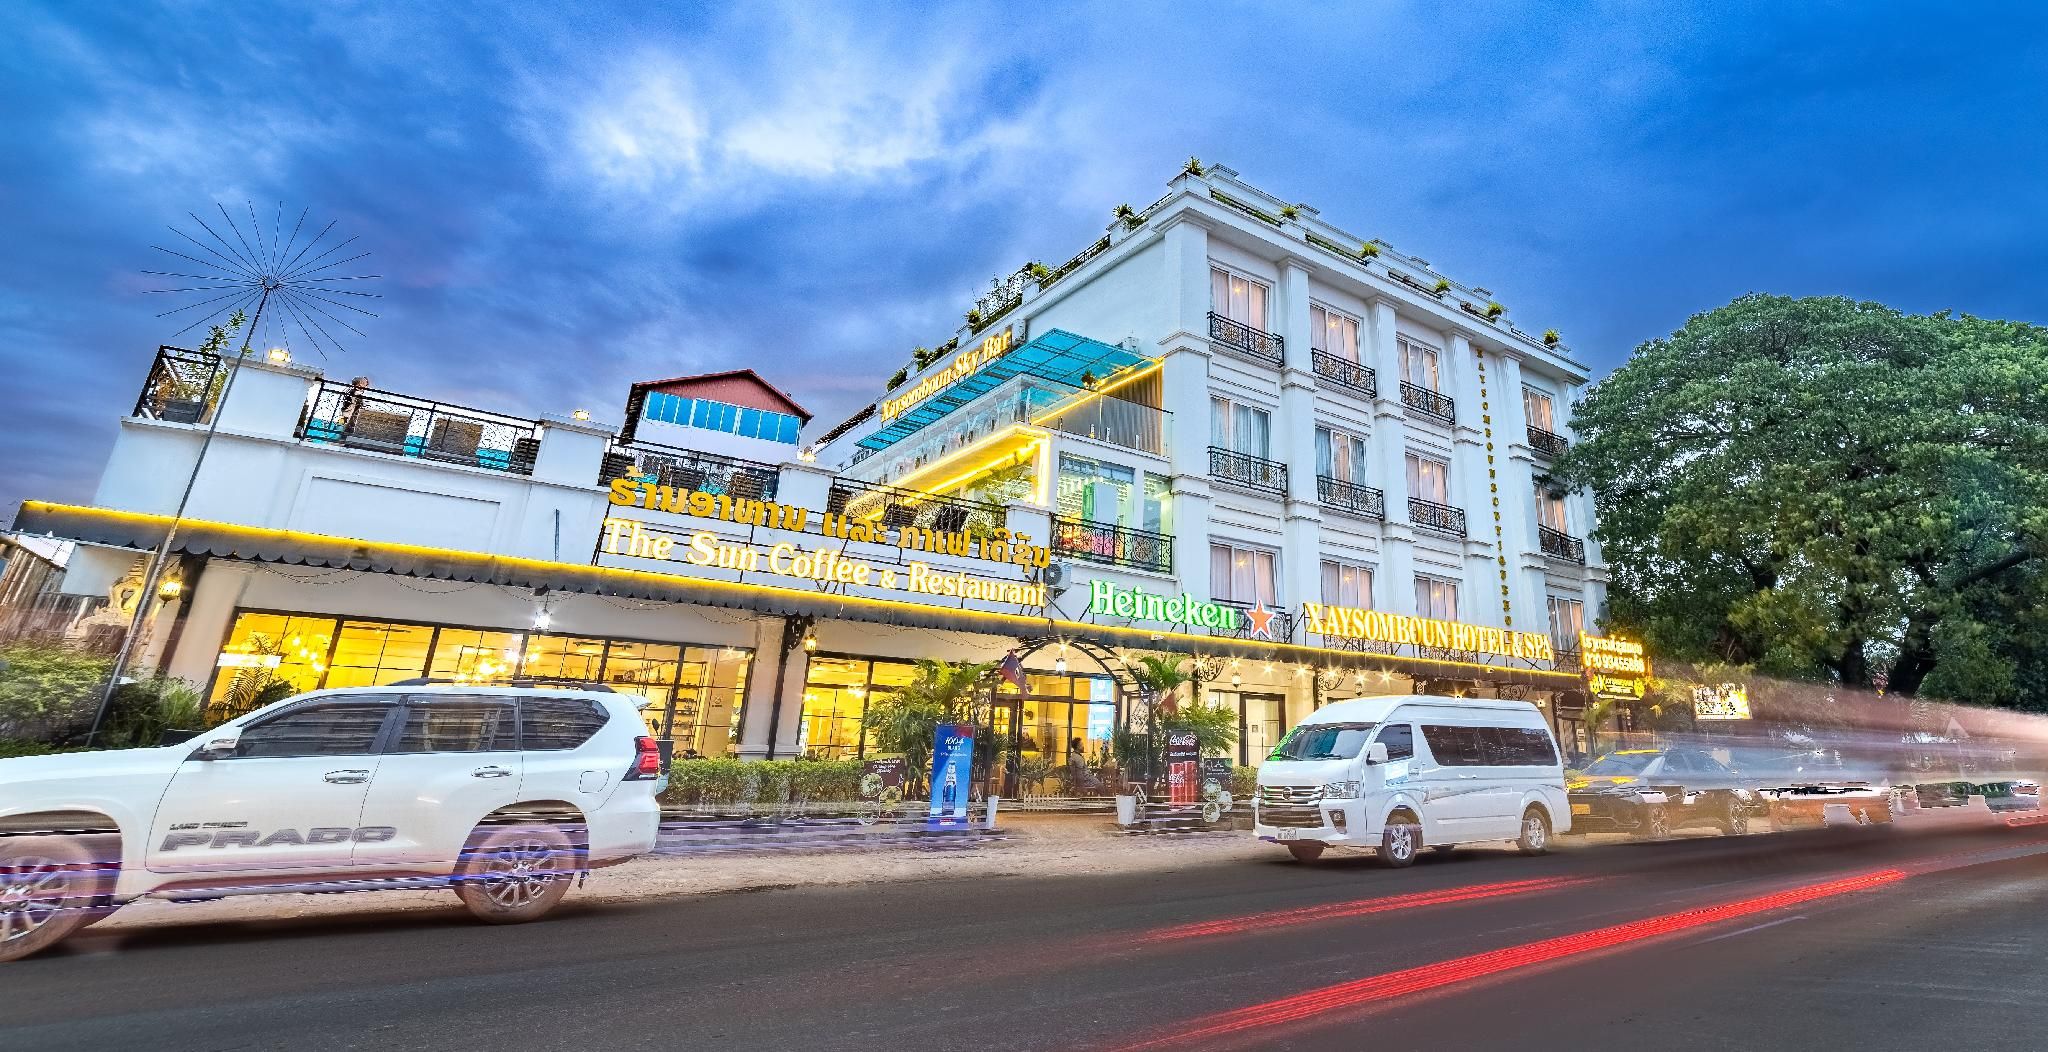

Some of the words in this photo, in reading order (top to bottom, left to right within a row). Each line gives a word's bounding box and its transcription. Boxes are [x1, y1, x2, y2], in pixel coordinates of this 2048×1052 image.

[954, 350, 980, 376] Sky
[982, 331, 1012, 363] Bar
[604, 517, 674, 561] The
[686, 531, 758, 572] Sun
[768, 542, 870, 585] Coffee
[880, 569, 896, 589] &
[908, 560, 1047, 607] Restaurant
[1089, 579, 1237, 629] Heineken
[1304, 602, 1449, 648] XAYSOMBOUN
[1450, 621, 1511, 655] HOTEL
[1511, 630, 1525, 657] &
[1524, 631, 1554, 661] SPA
[159, 826, 398, 852] PRADO
